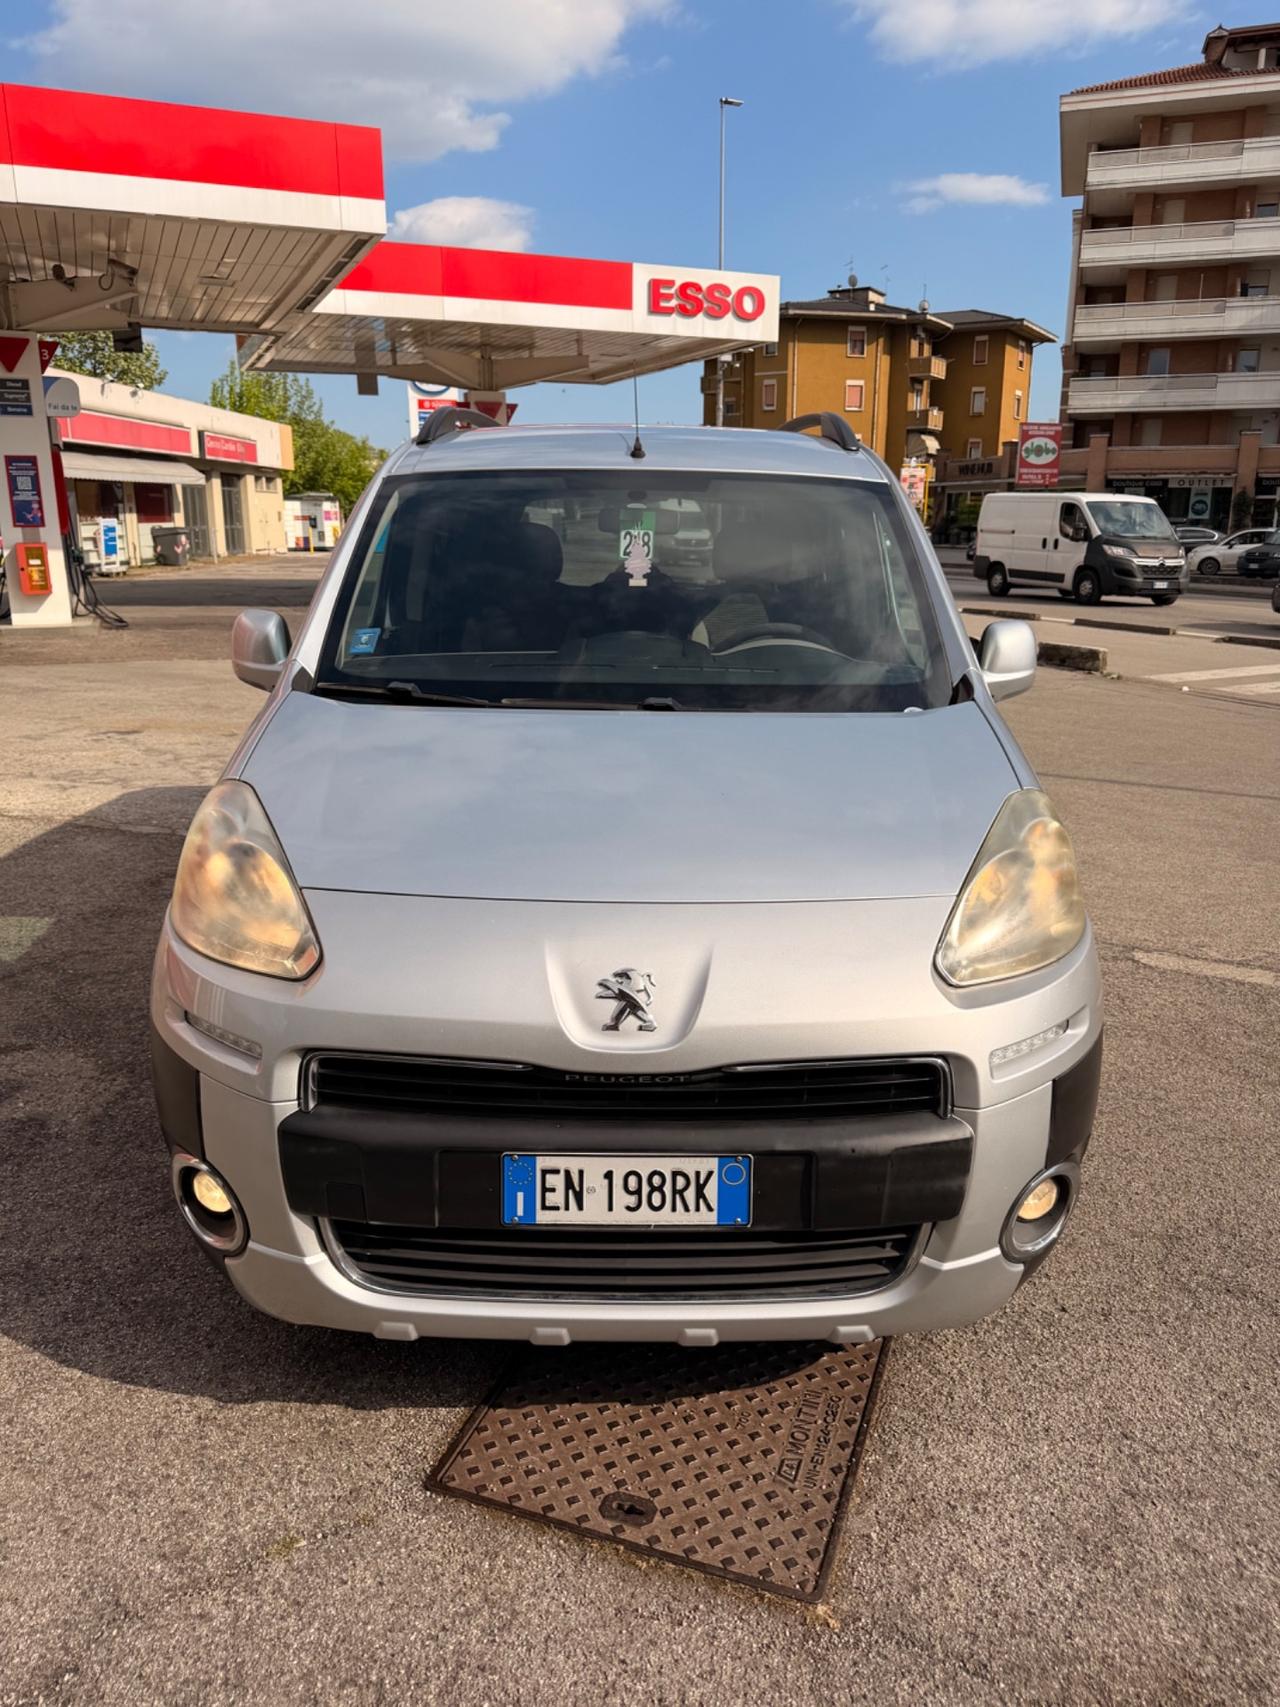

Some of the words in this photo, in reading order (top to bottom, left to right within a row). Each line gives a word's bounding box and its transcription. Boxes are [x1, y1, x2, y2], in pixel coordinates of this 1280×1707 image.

[647, 278, 766, 321] ESSO
[41, 349, 49, 360] 3
[1177, 479, 1225, 487] OUTLET
[565, 1074, 690, 1083] PEUGEOT
[541, 1169, 584, 1211] EN
[603, 1170, 714, 1212] 198RK
[786, 1388, 823, 1455] MONTINI
